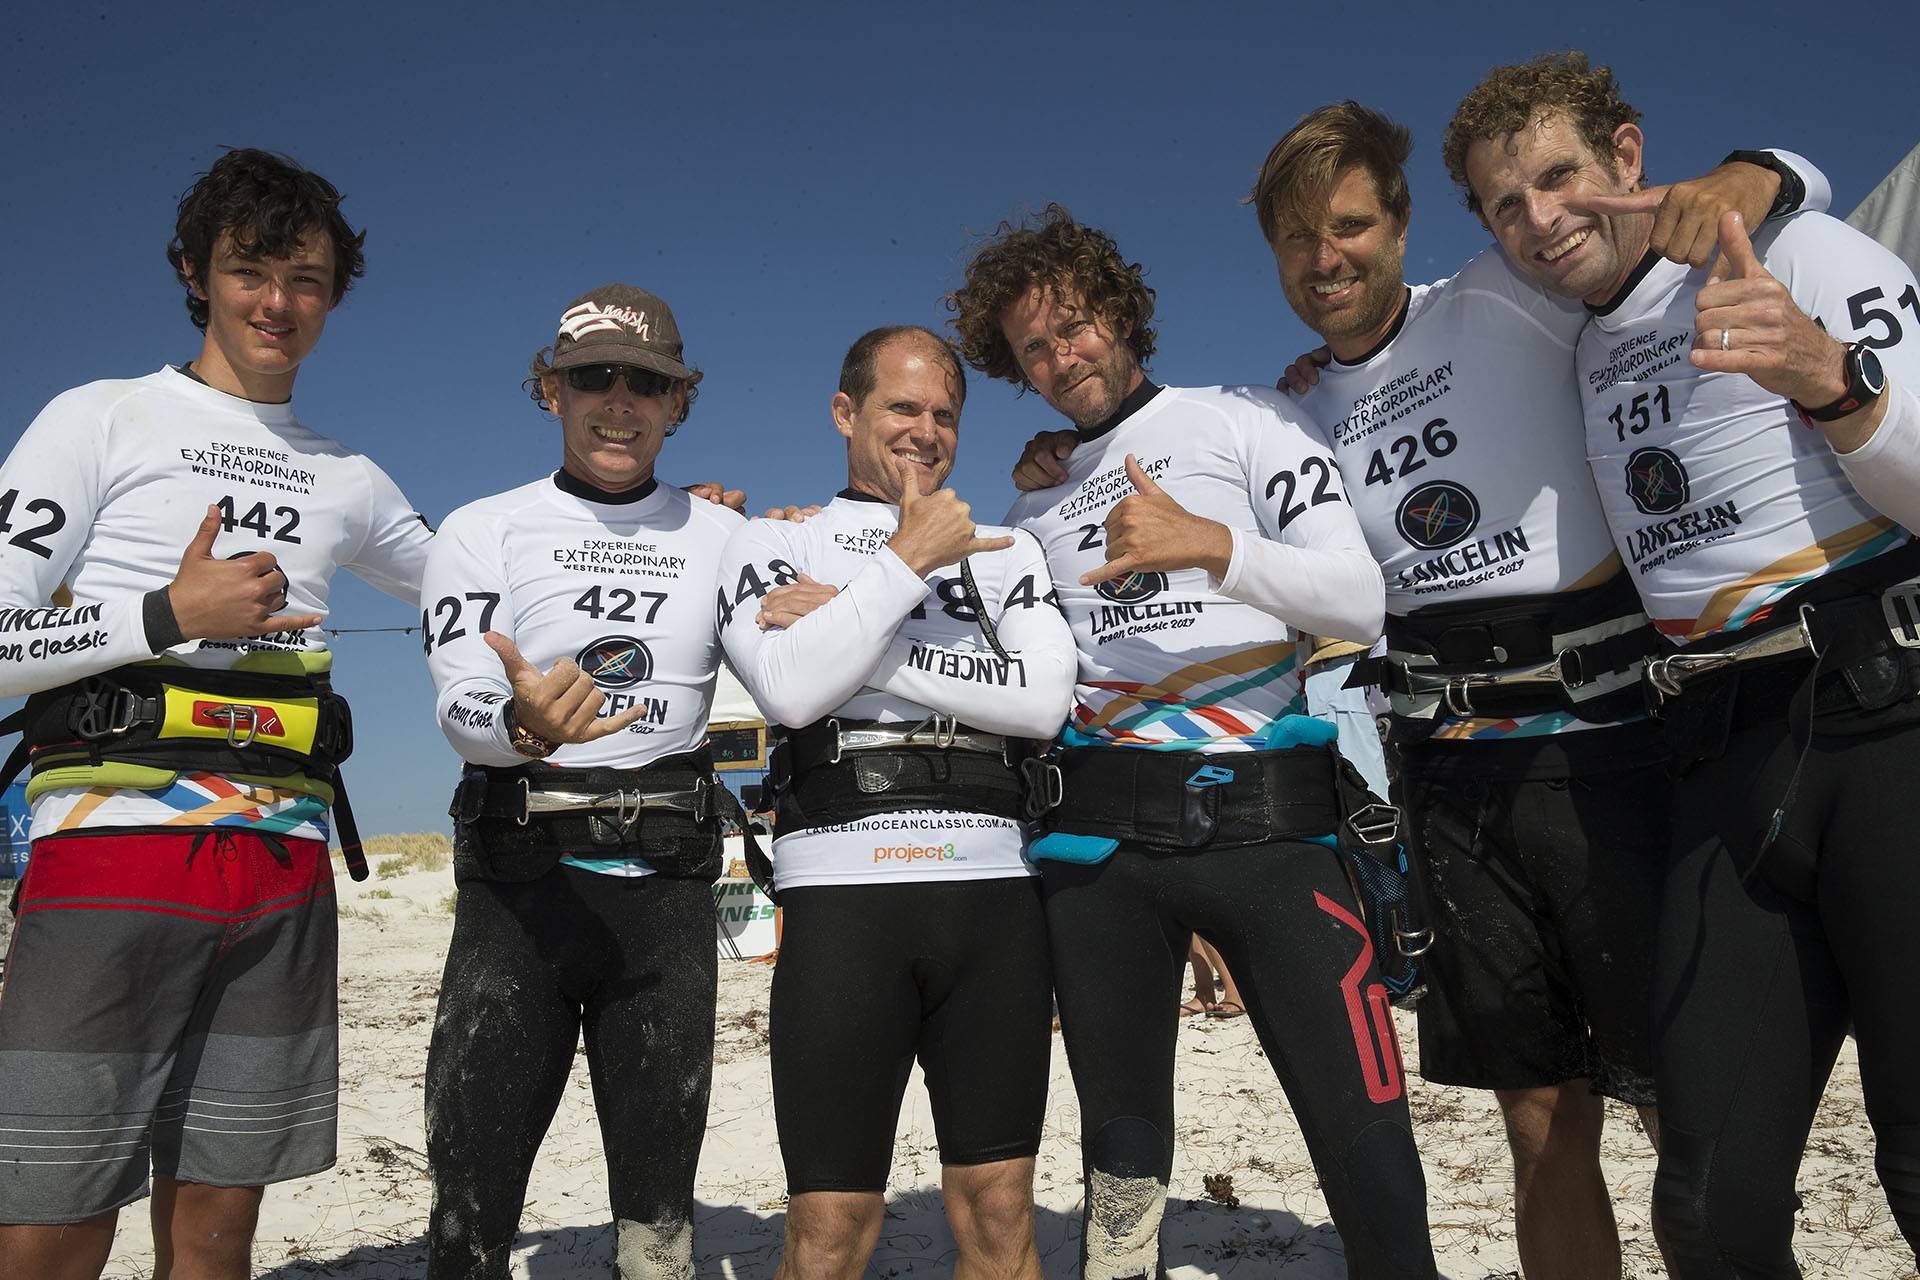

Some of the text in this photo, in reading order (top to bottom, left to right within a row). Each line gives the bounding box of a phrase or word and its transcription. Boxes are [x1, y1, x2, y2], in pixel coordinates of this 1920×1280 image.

[1633, 354, 1681, 382] AUSTRALIA
[1334, 361, 1454, 439] EXTRAORDINARY
[1354, 368, 1419, 412] EXPERIENCE
[1342, 384, 1451, 447] WESTERN AUSTRALIA
[1608, 384, 1671, 443] 151
[181, 448, 316, 487] EXTRAORDINARY
[213, 442, 289, 463] EXPERIENCE
[1364, 417, 1458, 487] 426
[192, 464, 310, 495] WESTERN AUSTRALIA
[216, 494, 302, 545] 442
[1064, 499, 1107, 521] WESTERN
[583, 540, 657, 553] EXPERIENCE
[1626, 500, 1742, 564] LANCELIN
[554, 549, 686, 571] EXTRAORDINARY
[563, 564, 679, 579] WESTERN AUSTRALIA
[1399, 525, 1530, 590] LANCELIN
[1447, 571, 1495, 590] Classic
[1496, 558, 1525, 577] 2017
[573, 585, 669, 625] 427
[717, 558, 801, 638] 448
[29, 629, 108, 660] Classic
[422, 591, 501, 658] 427
[1127, 620, 1168, 637] Classic
[1170, 617, 1196, 629] 2017
[907, 645, 1027, 688] LANCELIN
